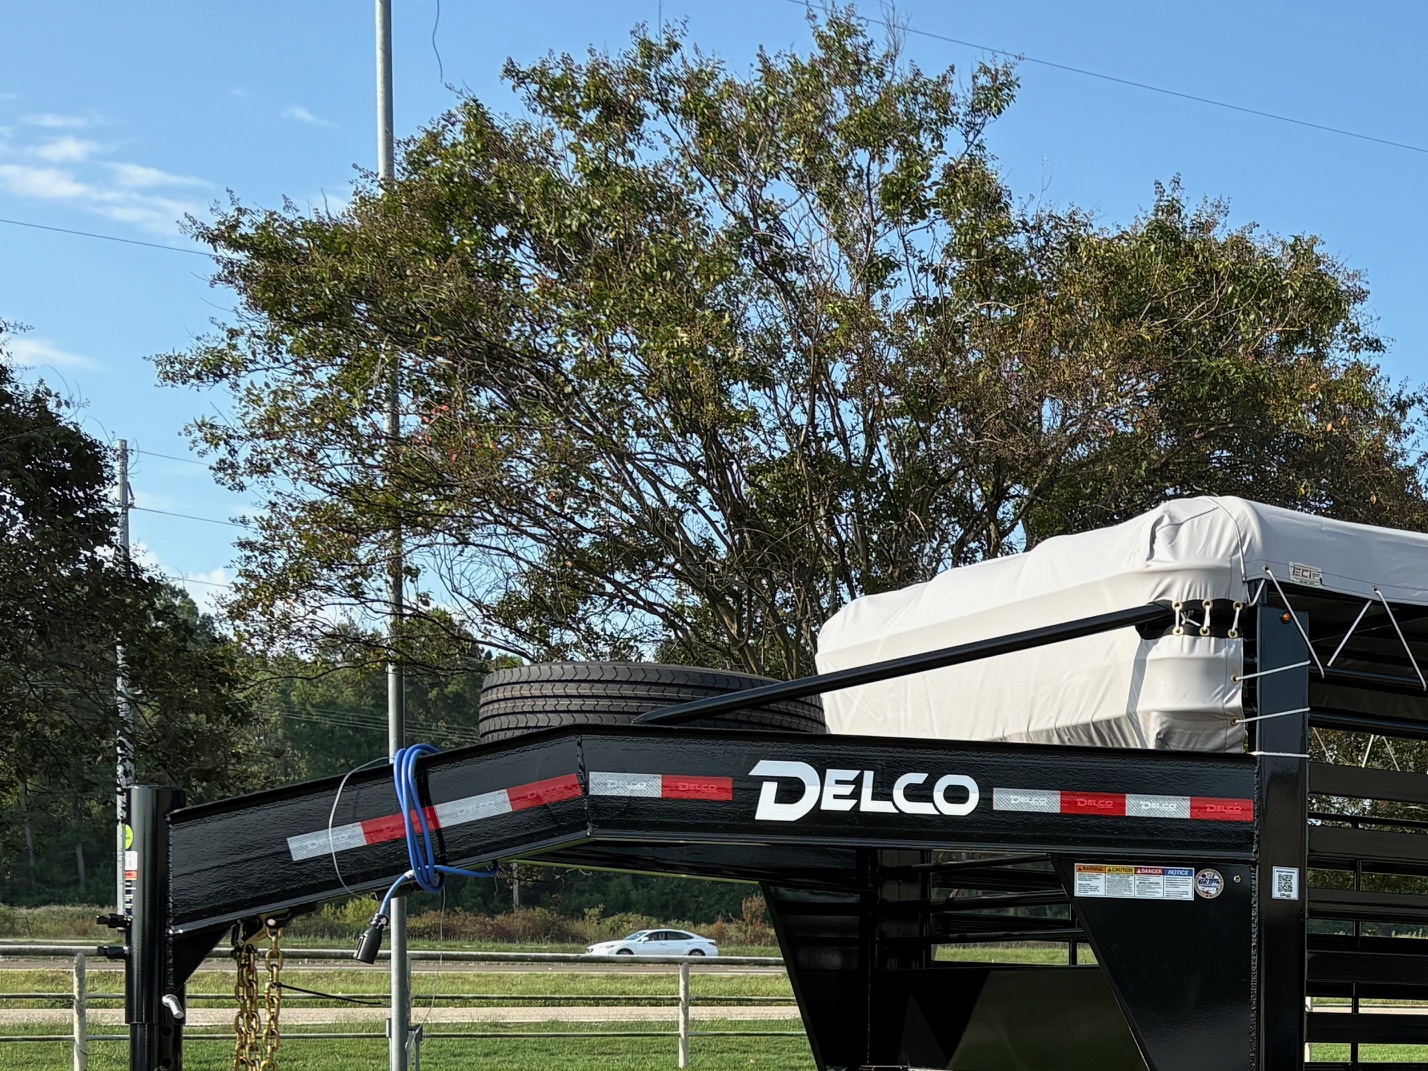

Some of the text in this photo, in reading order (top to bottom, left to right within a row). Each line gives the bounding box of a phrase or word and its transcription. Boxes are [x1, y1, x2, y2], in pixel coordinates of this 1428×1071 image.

[677, 782, 718, 793] DELCO
[748, 760, 980, 822] DELCO
[1010, 795, 1048, 806] DELCO
[1076, 798, 1114, 808] DELCO
[1140, 801, 1177, 812] DELCO
[1205, 804, 1242, 814] DELCO
